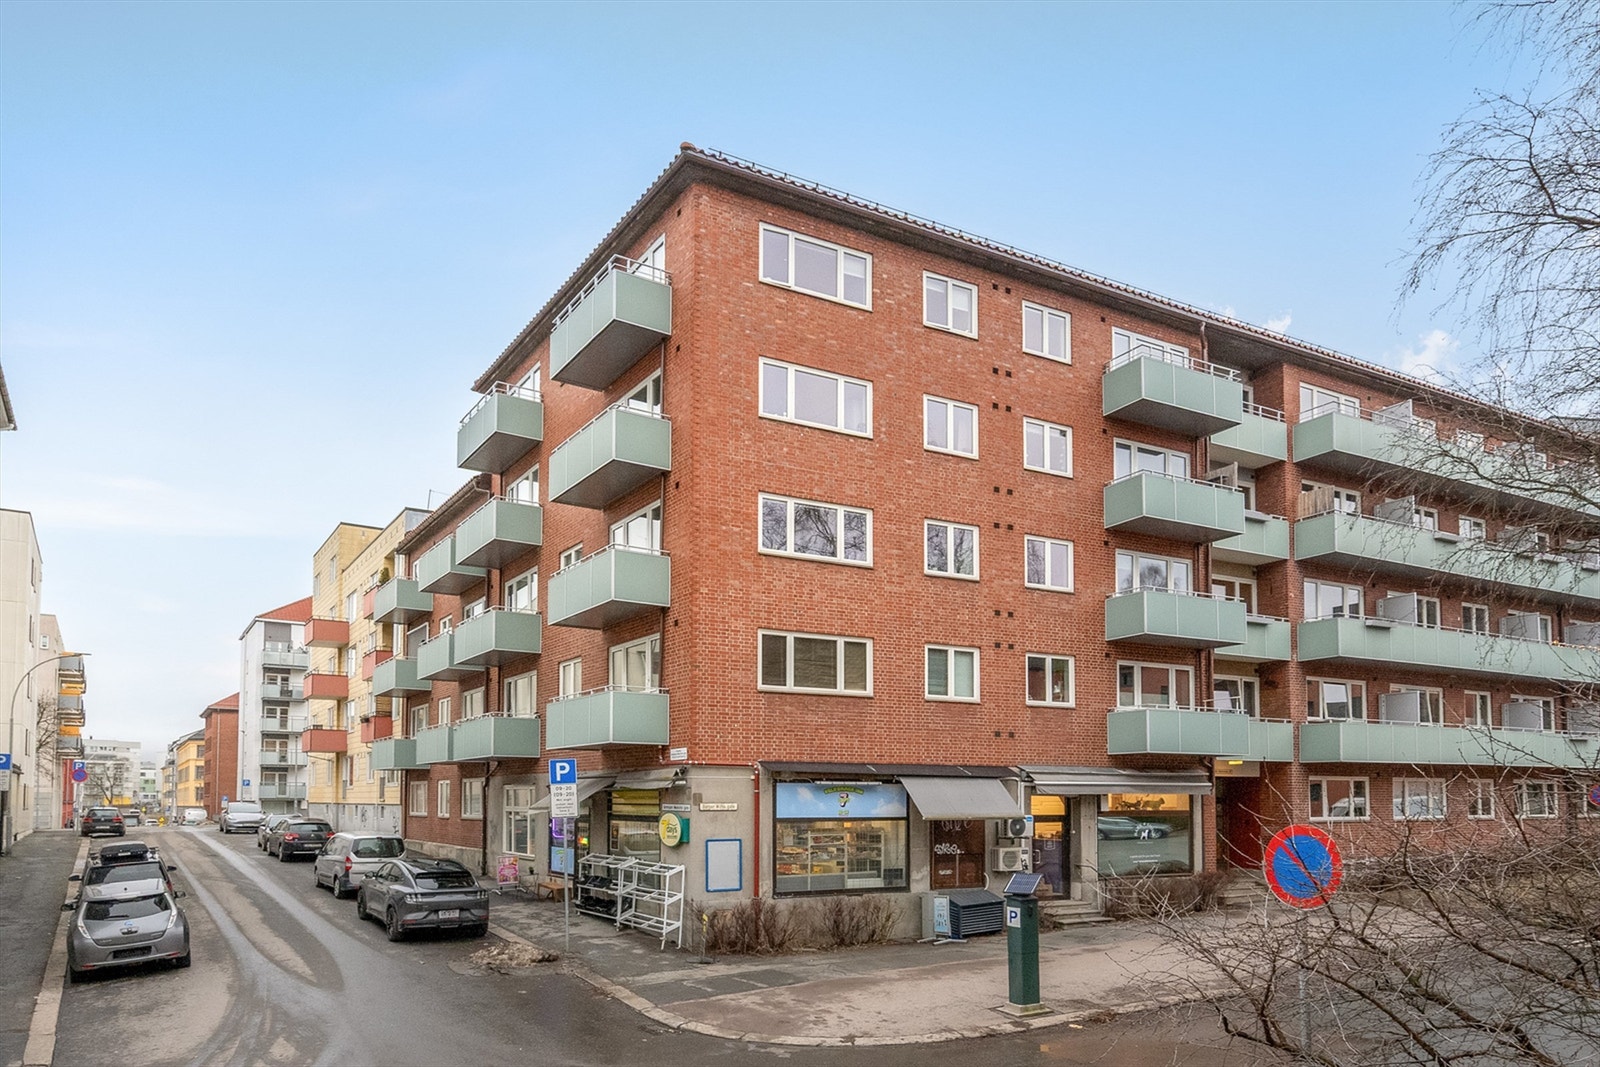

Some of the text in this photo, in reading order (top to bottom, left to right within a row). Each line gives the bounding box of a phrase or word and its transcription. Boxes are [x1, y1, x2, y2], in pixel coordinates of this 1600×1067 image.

[555, 762, 570, 781] P
[661, 819, 669, 839] 7
[1009, 910, 1018, 923] P
